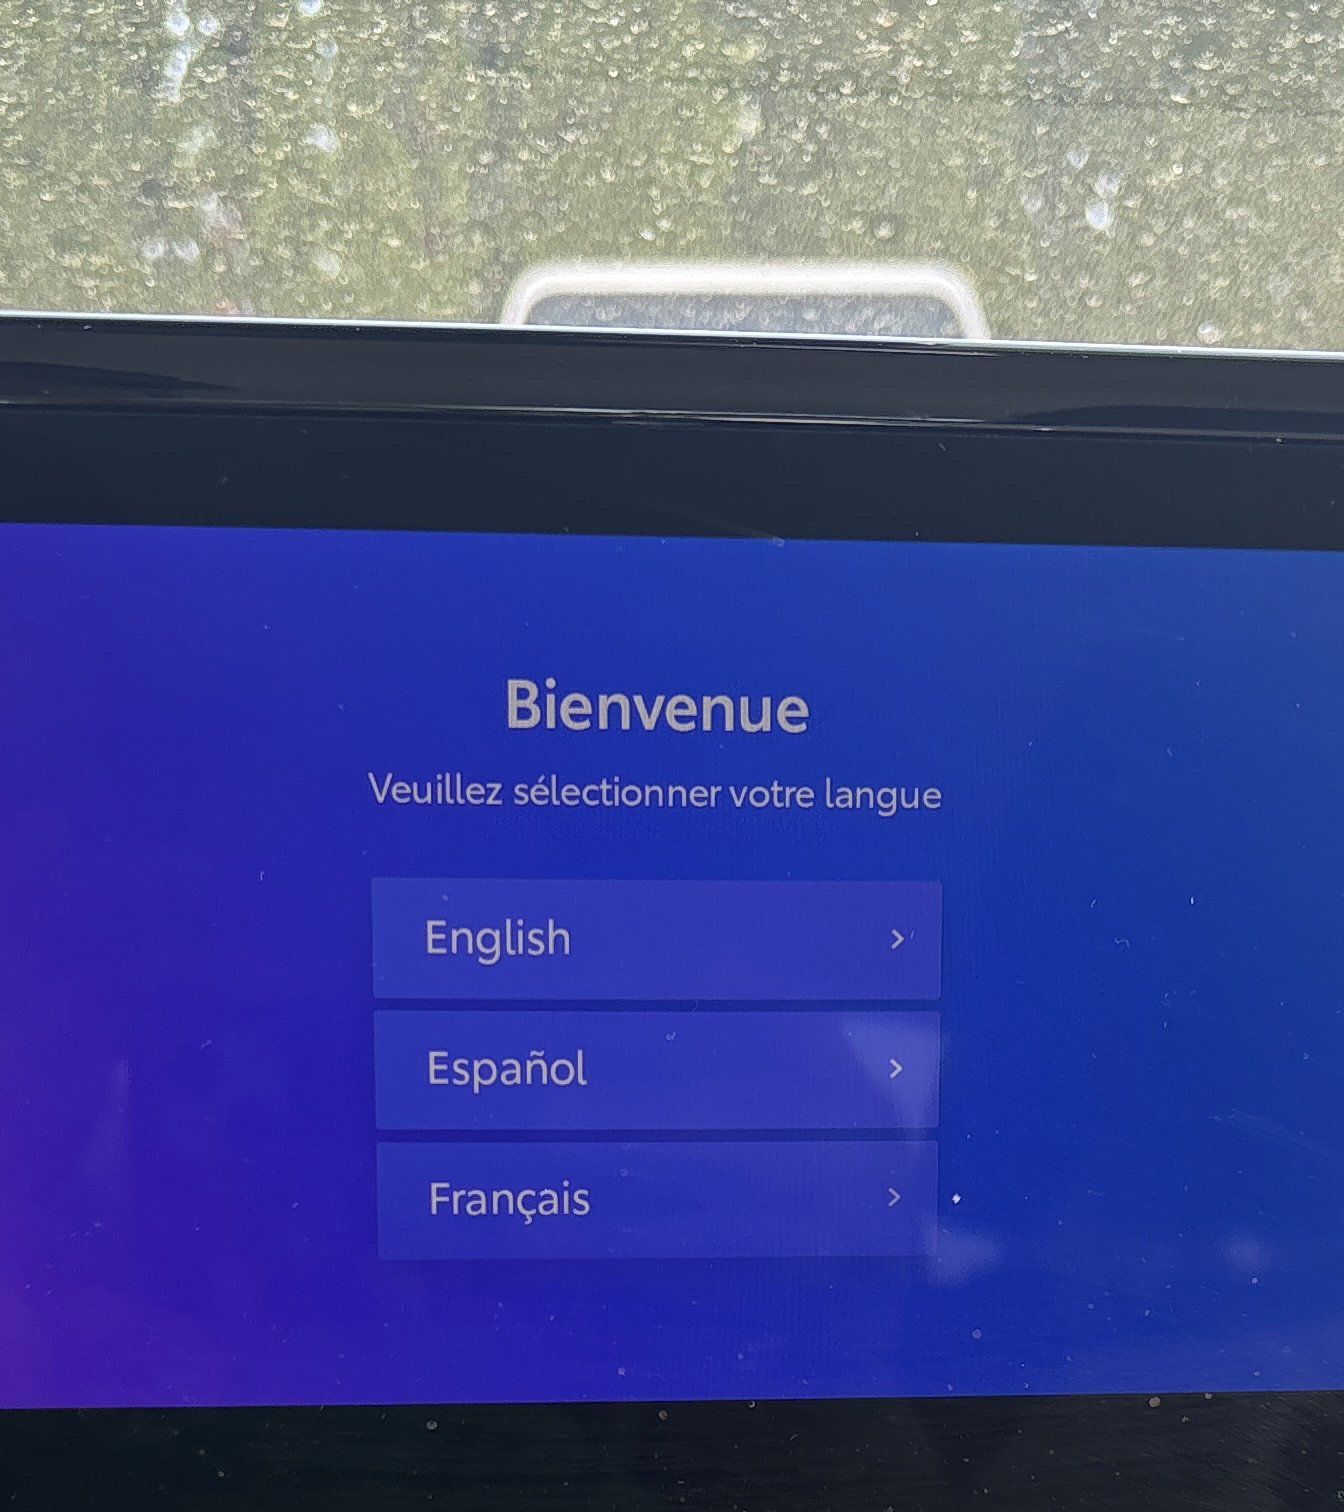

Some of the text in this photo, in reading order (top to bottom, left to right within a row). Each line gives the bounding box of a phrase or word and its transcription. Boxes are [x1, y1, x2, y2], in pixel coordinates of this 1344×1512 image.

[507, 677, 809, 734] Bienvenue
[367, 772, 942, 817] Veuillez sélectionner votre langue
[426, 918, 570, 965] English
[428, 1049, 588, 1094] Español
[430, 1180, 590, 1225] Français
